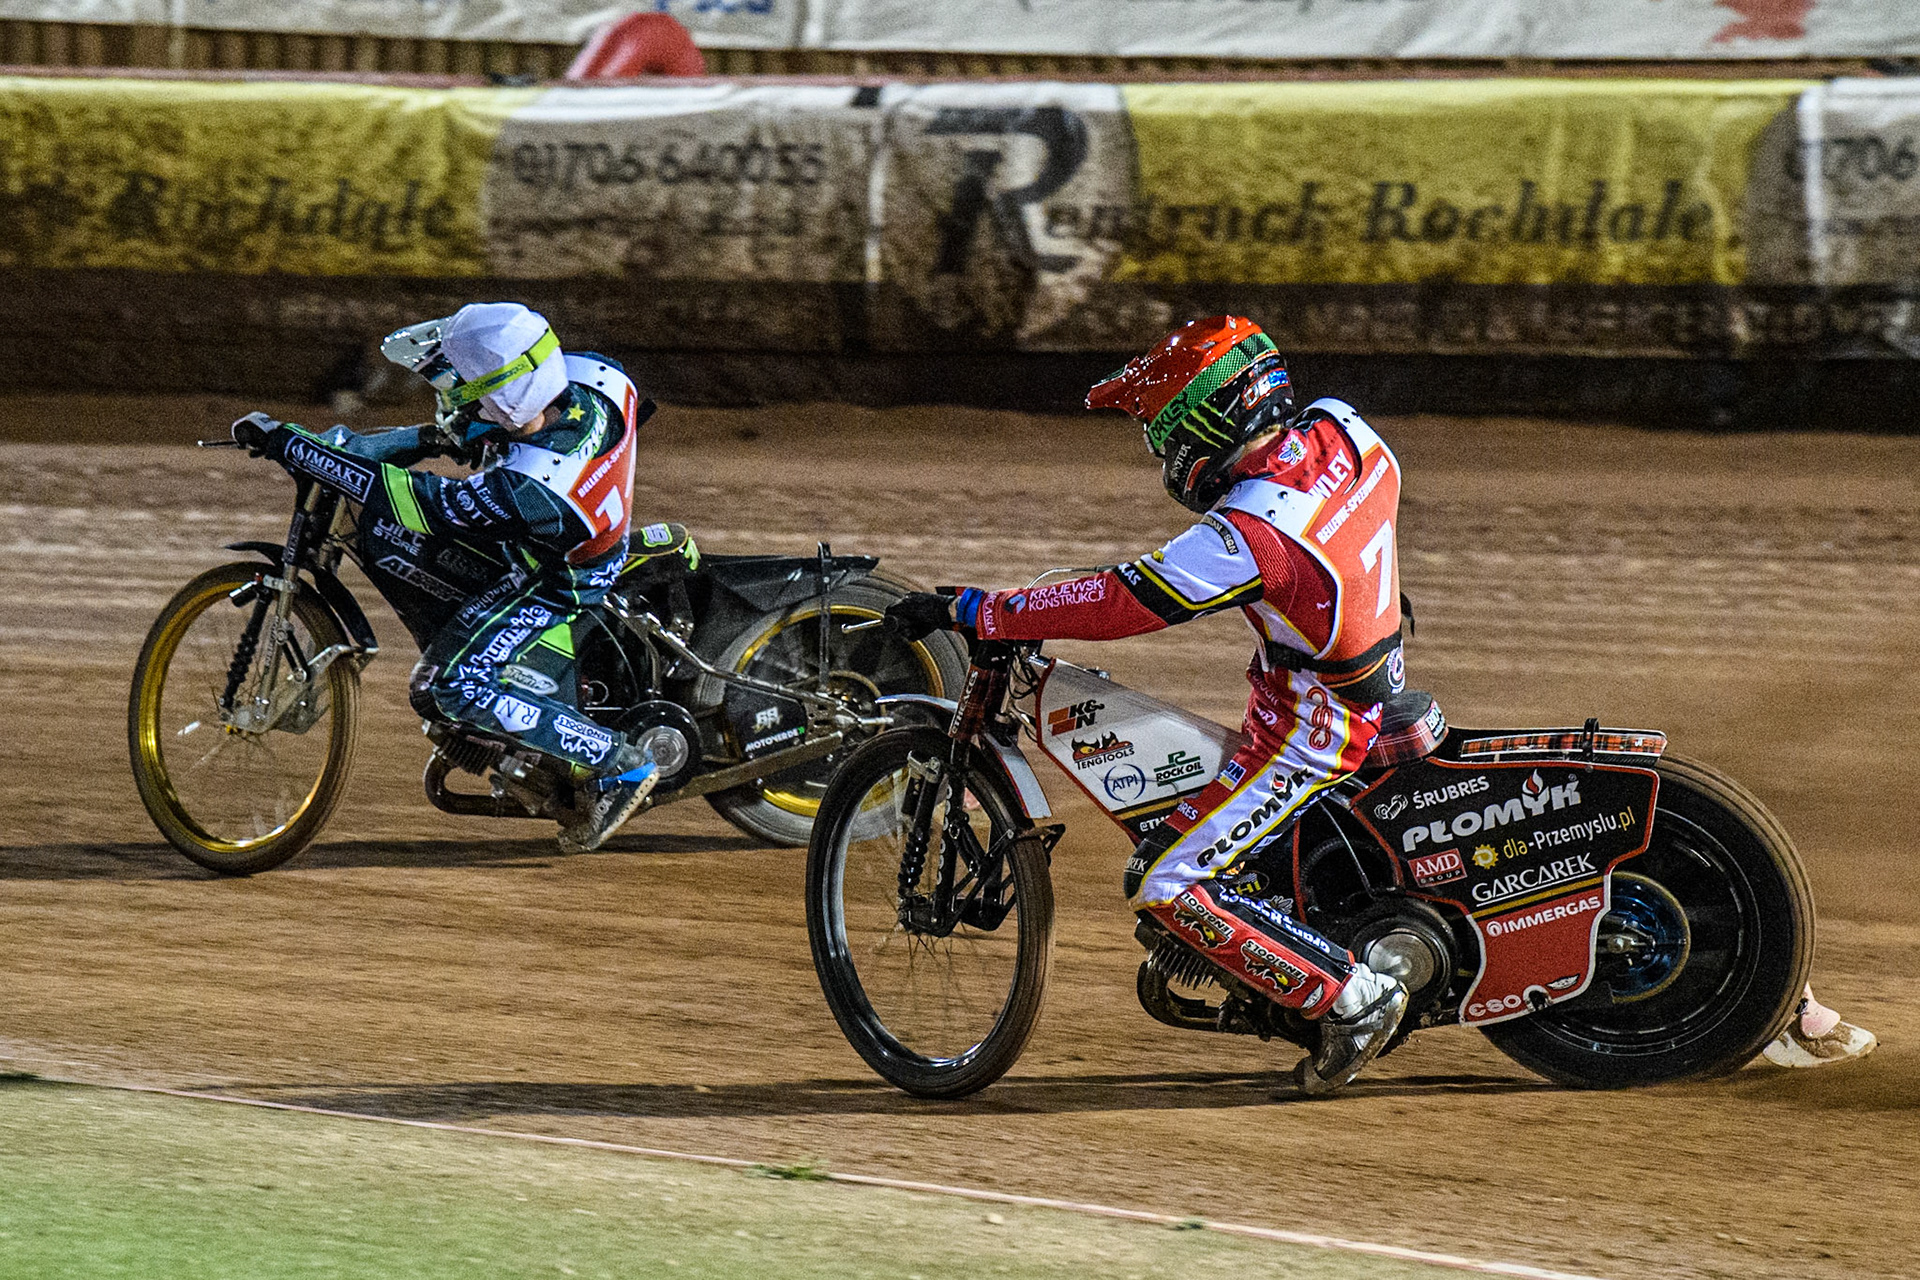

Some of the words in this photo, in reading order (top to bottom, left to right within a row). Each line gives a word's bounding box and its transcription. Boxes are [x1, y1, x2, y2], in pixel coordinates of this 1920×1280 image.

[305, 448, 367, 490] IMPAKT
[372, 526, 421, 557] STORE
[1359, 518, 1393, 620] 7
[1028, 589, 1107, 612] KONSTRUKCJE
[1029, 577, 1107, 601] KRAJEWSKI
[1111, 773, 1139, 792] ATPI
[1155, 766, 1184, 783] ROCK
[1185, 761, 1203, 774] OIL
[1413, 776, 1490, 810] ŚRUBRES
[1402, 778, 1582, 853] PŁOMYK
[1503, 806, 1636, 859] dla-Przemyslu.pl
[1416, 853, 1460, 877] AMD
[1420, 870, 1462, 885] GROUP
[1471, 852, 1596, 902] GARCAREK
[1181, 891, 1235, 938] TENGTOOL
[1504, 895, 1602, 934] IMMERGAS
